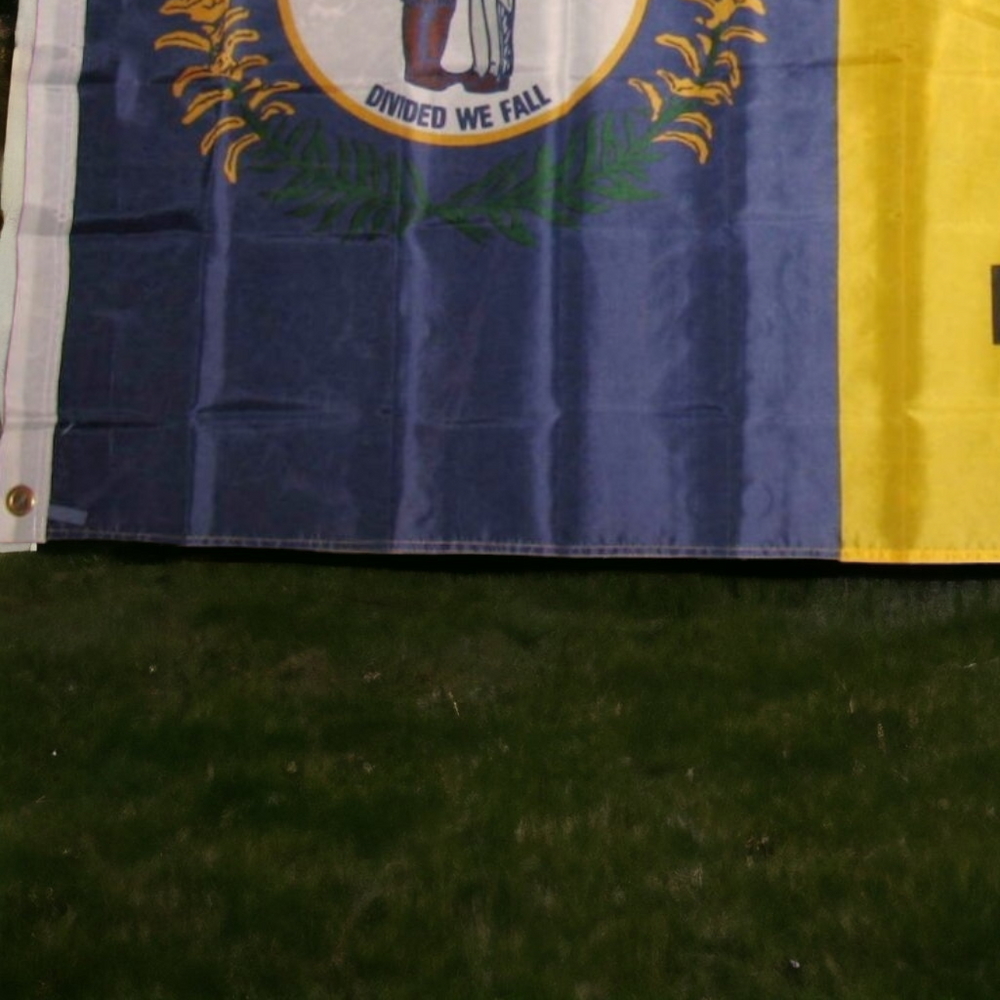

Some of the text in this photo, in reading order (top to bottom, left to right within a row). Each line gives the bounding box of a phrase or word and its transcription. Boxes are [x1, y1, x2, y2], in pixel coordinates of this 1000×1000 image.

[365, 84, 553, 131] DIVIDED WE FALL
